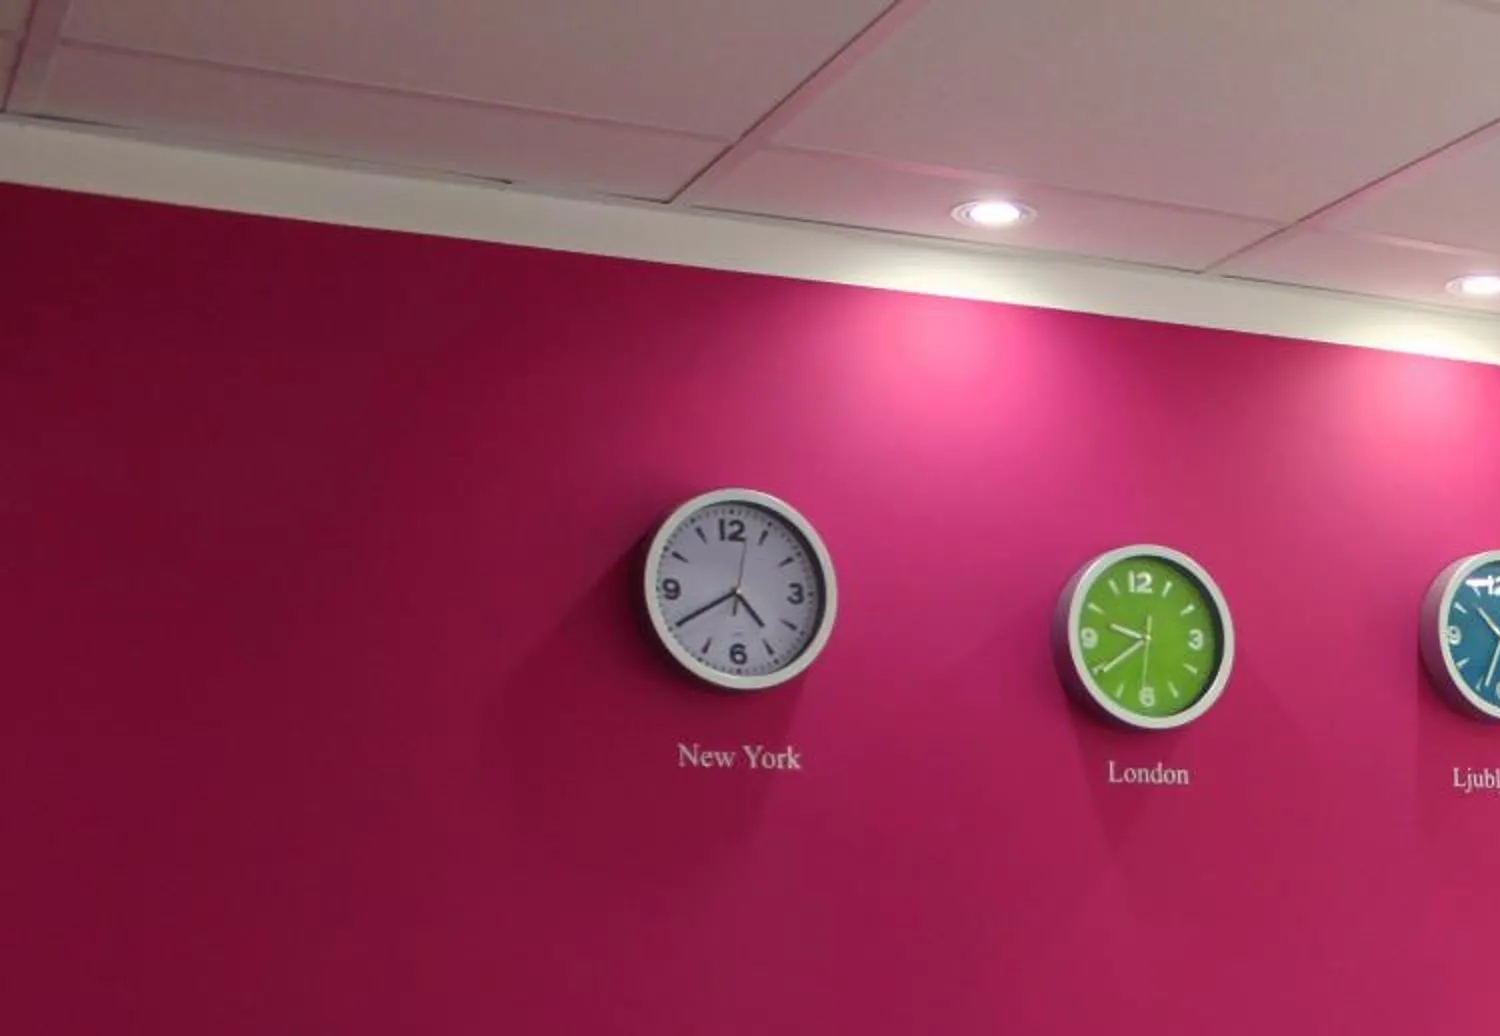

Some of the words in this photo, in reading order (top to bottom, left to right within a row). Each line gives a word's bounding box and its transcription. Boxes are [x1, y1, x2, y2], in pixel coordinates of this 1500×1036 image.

[717, 519, 746, 542] 12
[662, 578, 681, 600] 9
[1128, 571, 1153, 593] 12
[786, 582, 805, 605] 3
[1080, 627, 1098, 648] 9
[1188, 629, 1204, 650] 3
[1447, 625, 1462, 646] 9
[729, 642, 748, 665] 6
[1138, 687, 1156, 707] 6
[677, 743, 736, 769] New
[742, 745, 801, 770] York
[1108, 760, 1190, 785] London
